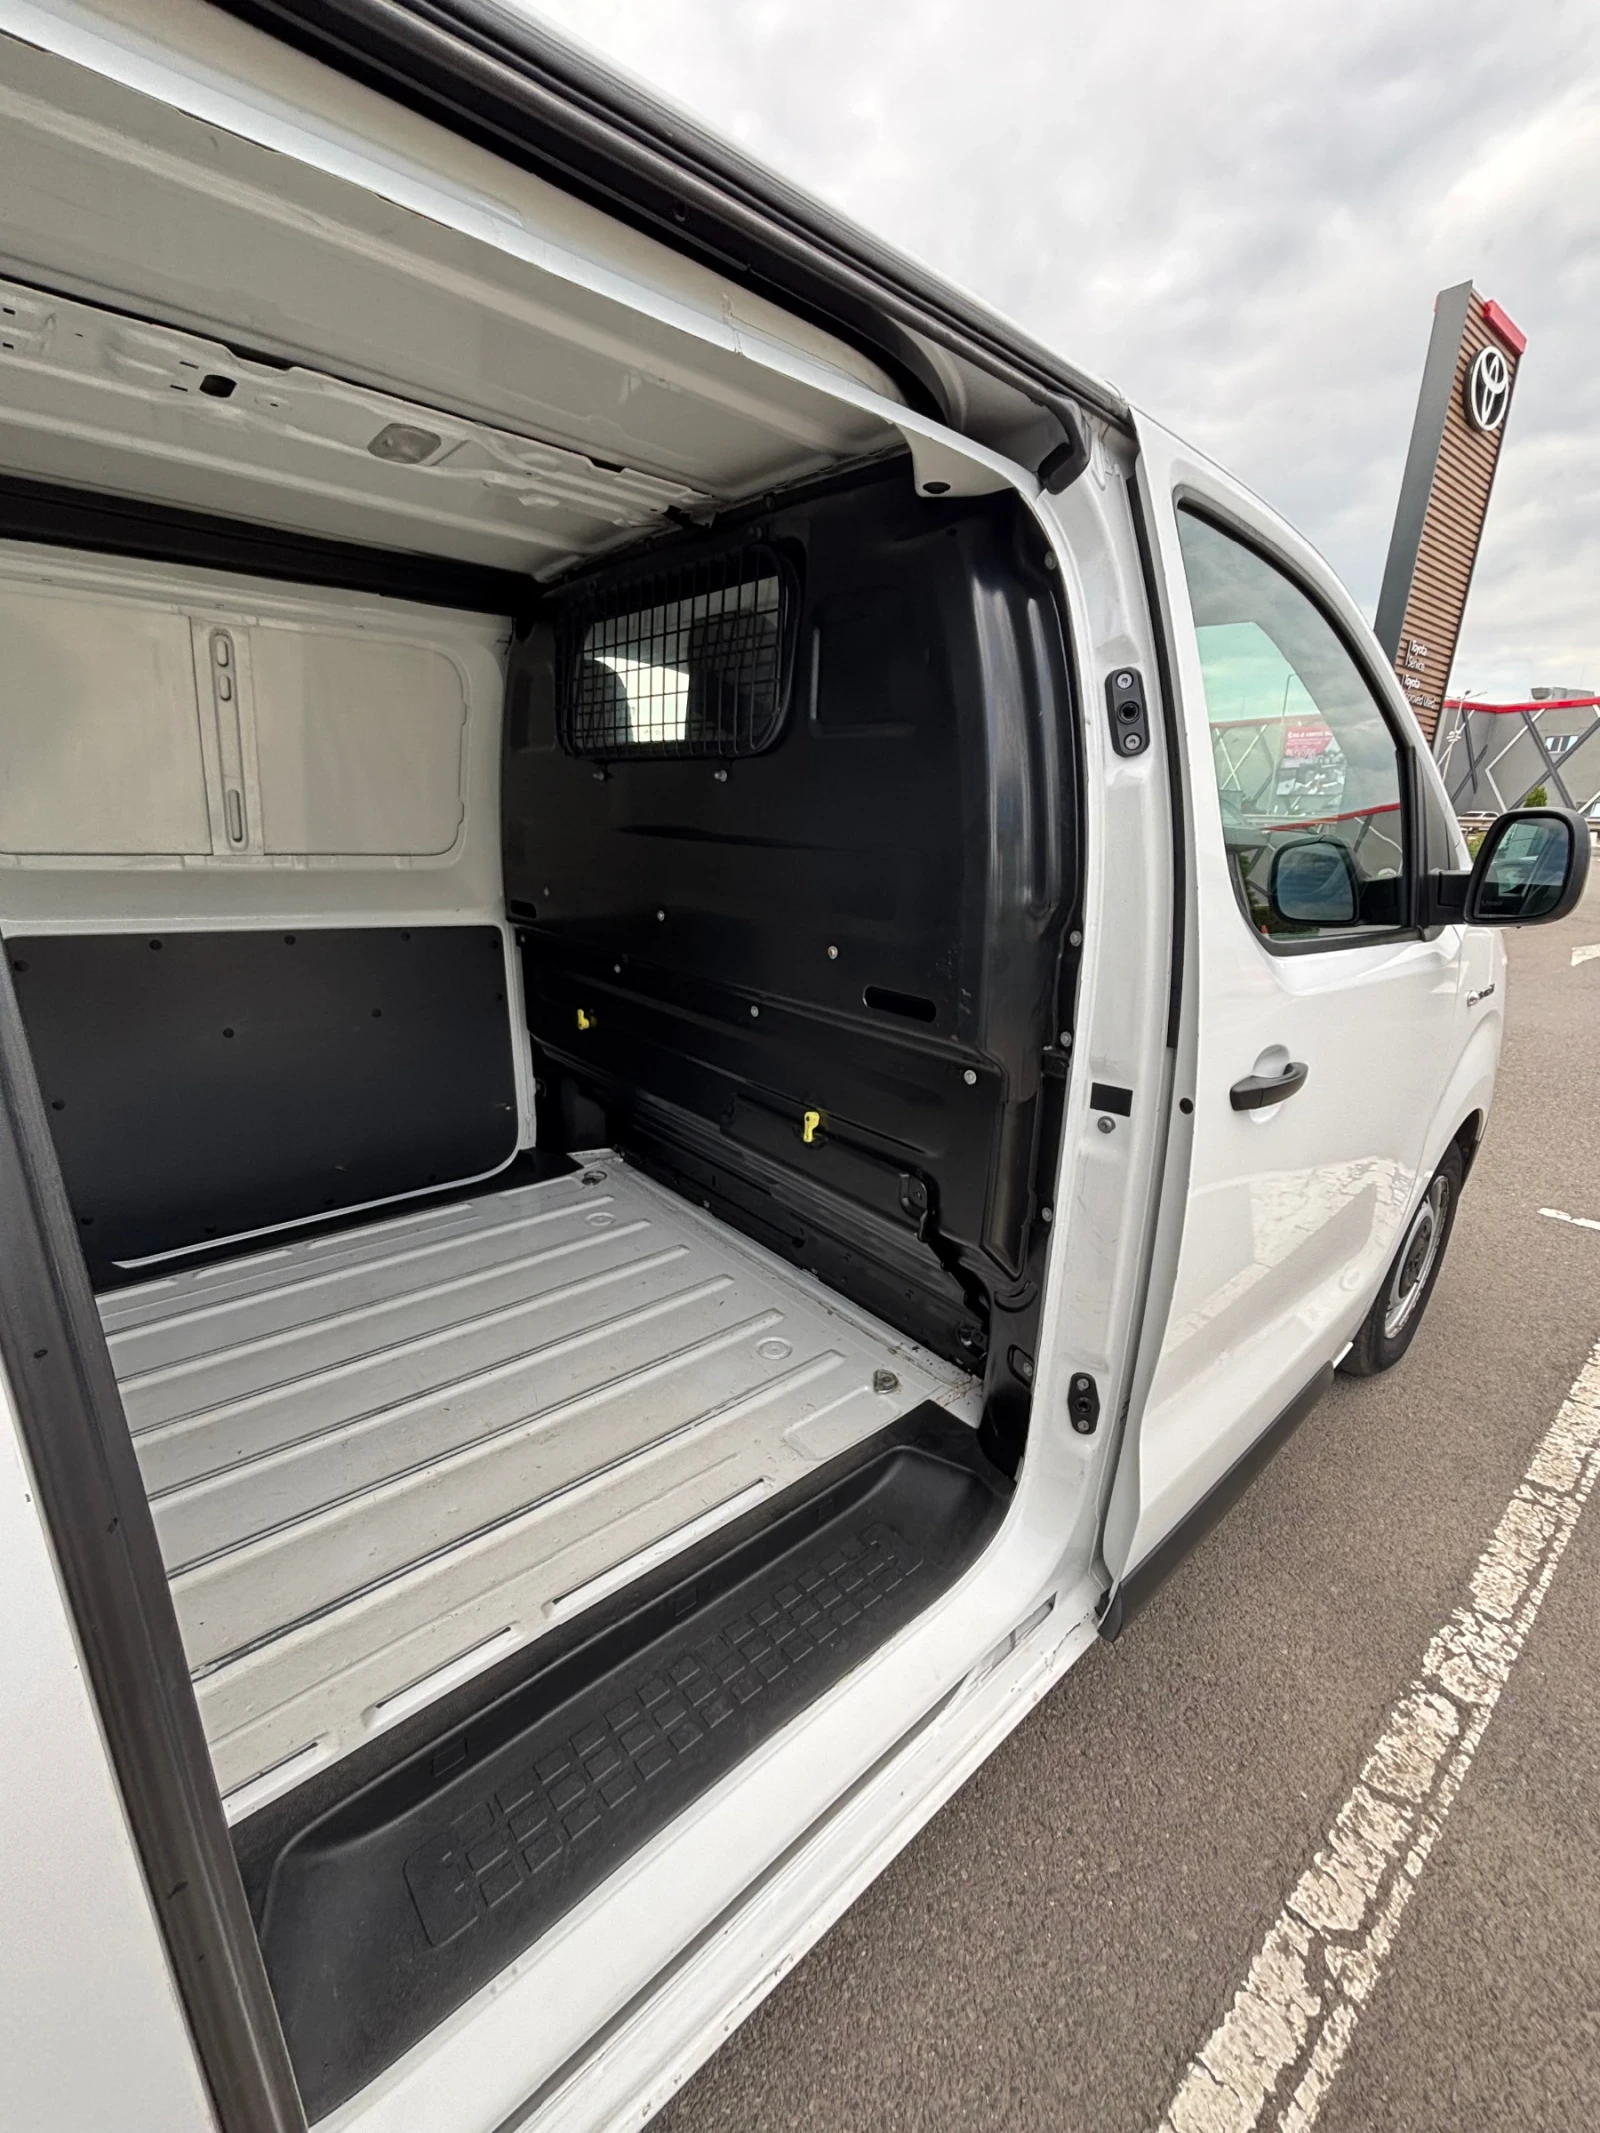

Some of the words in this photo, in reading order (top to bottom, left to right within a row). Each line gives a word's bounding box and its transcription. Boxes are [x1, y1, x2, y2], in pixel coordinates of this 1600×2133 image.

[1412, 640, 1427, 656] Toyota
[1408, 656, 1425, 671] Service
[1405, 674, 1420, 690] Toyota
